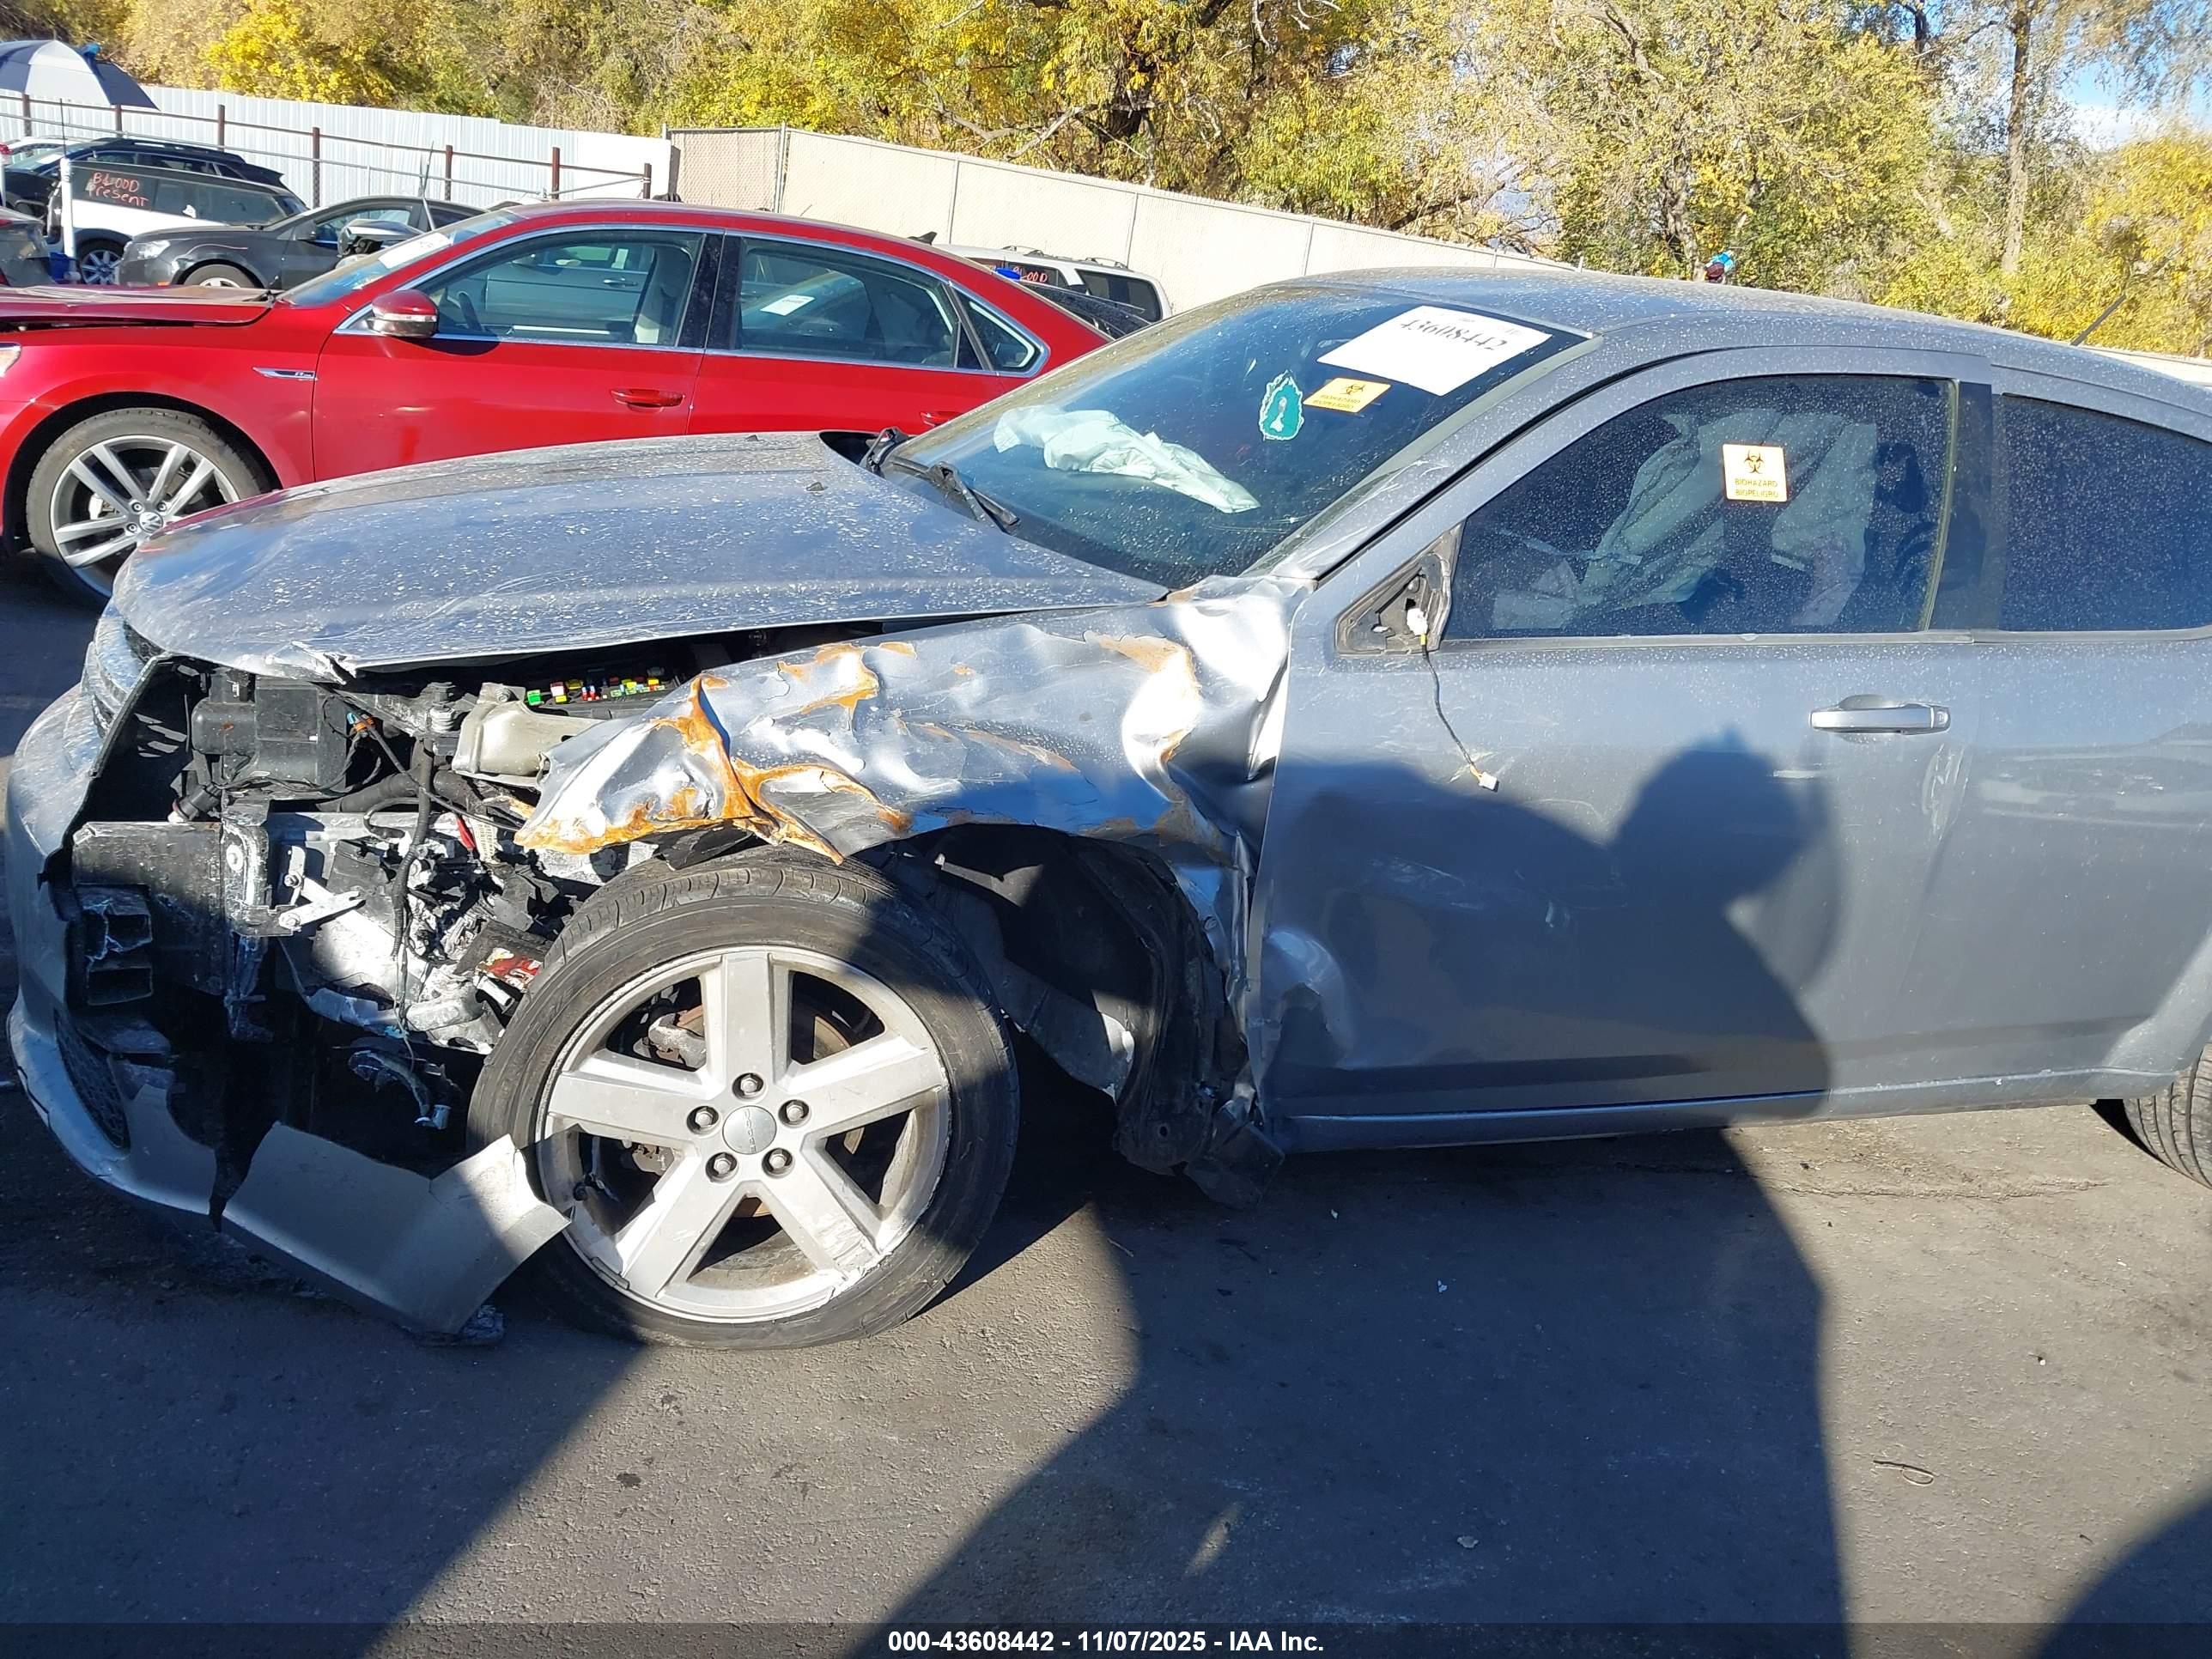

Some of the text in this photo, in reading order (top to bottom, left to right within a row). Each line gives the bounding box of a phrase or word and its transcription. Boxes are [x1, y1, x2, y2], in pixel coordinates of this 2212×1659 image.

[94, 173, 139, 192] BLOOD
[1401, 319, 1508, 350] 43608442
[1735, 477, 1778, 488] BIOHAZARD
[1735, 489, 1779, 498] BIOPELIGRO
